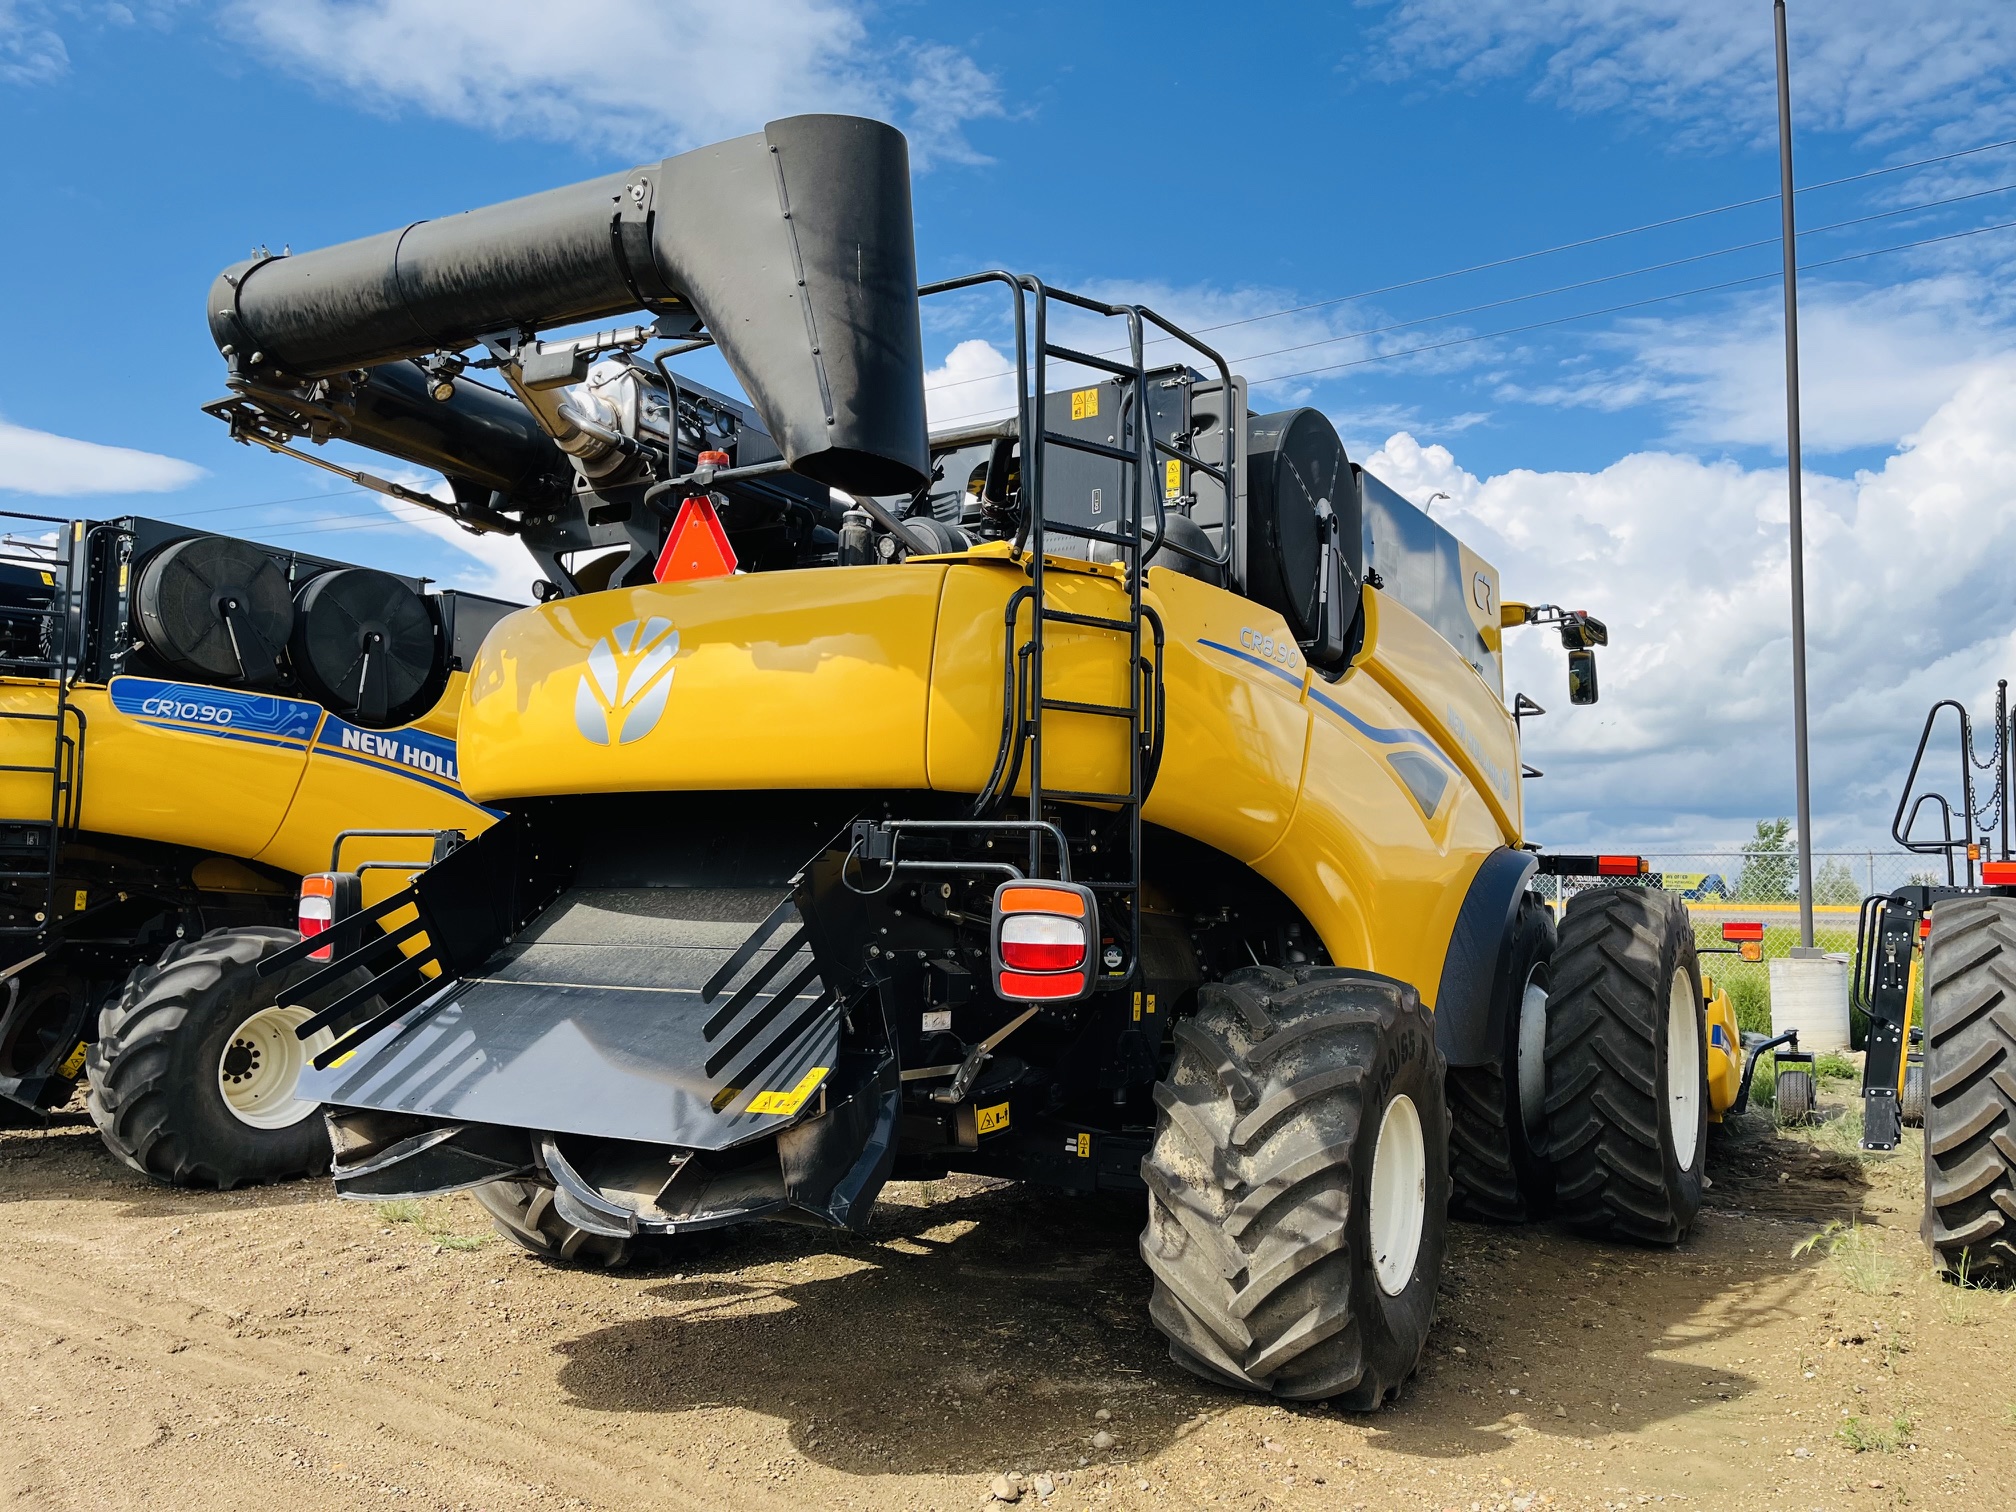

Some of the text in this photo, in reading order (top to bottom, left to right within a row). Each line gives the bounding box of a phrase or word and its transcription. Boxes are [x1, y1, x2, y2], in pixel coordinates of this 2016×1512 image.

[1472, 571, 1492, 615] CR
[1240, 626, 1298, 668] CR8.90
[142, 698, 233, 724] CR10.90
[342, 727, 459, 782] NEW HOLL
